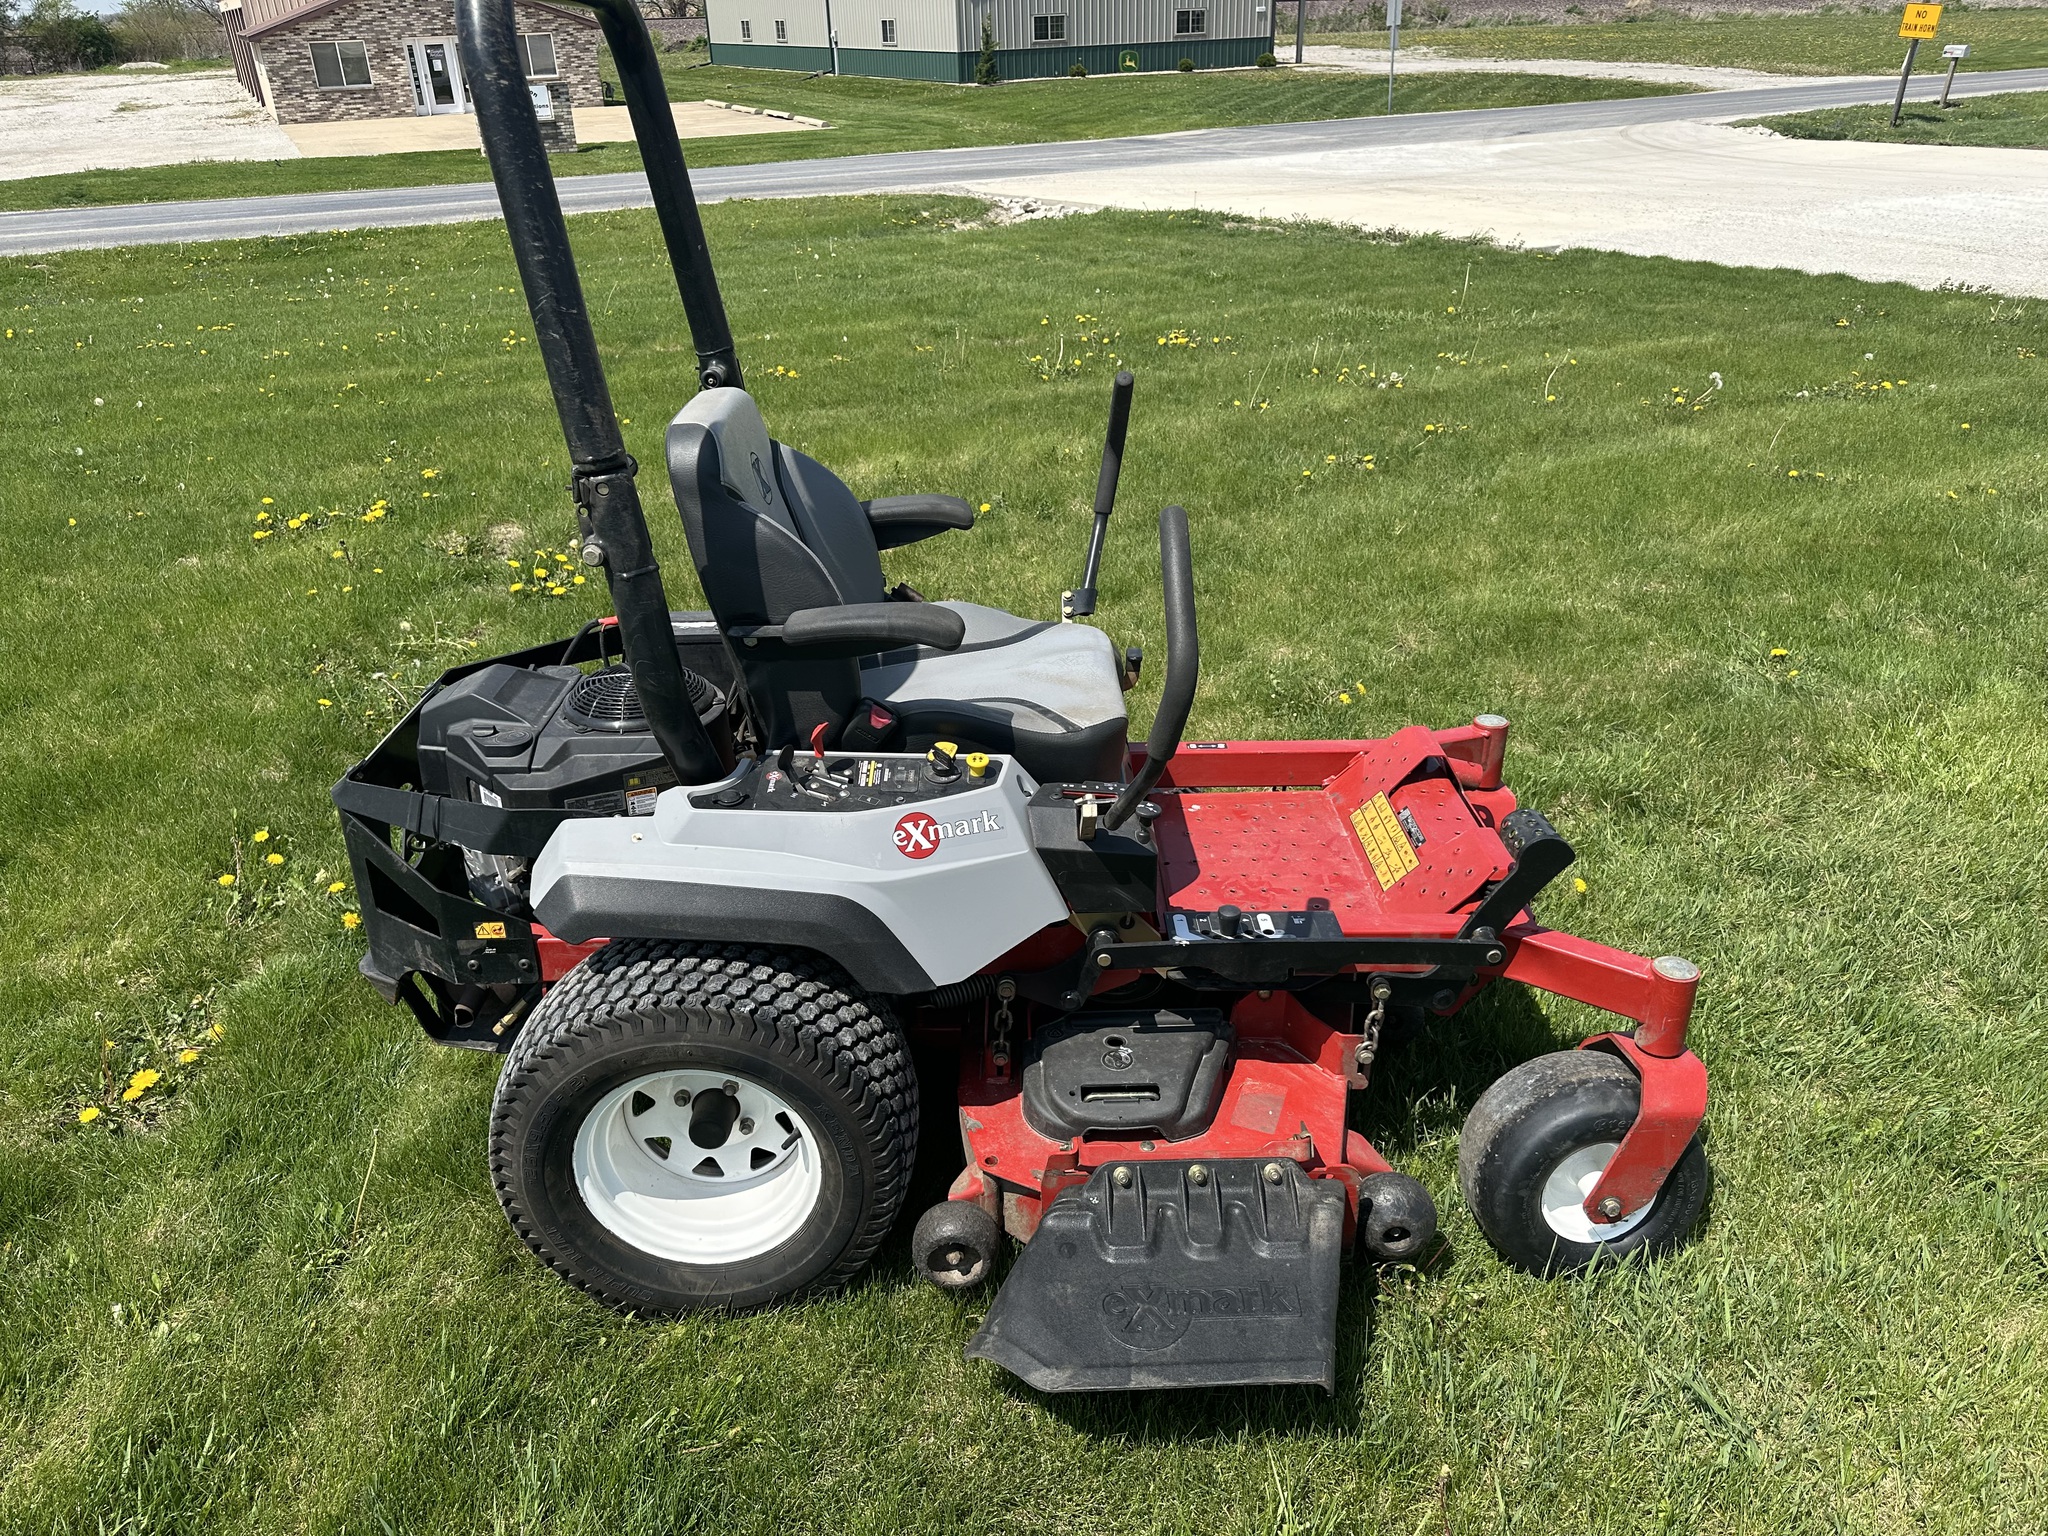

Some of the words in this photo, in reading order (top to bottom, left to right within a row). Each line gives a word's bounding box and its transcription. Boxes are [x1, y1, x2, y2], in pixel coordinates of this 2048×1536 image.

[1901, 22, 1918, 32] TRAIN
[1918, 24, 1935, 33] HORN
[1915, 10, 1928, 19] NO
[892, 810, 1000, 853] eXmark
[813, 1102, 861, 1179] KENDA
